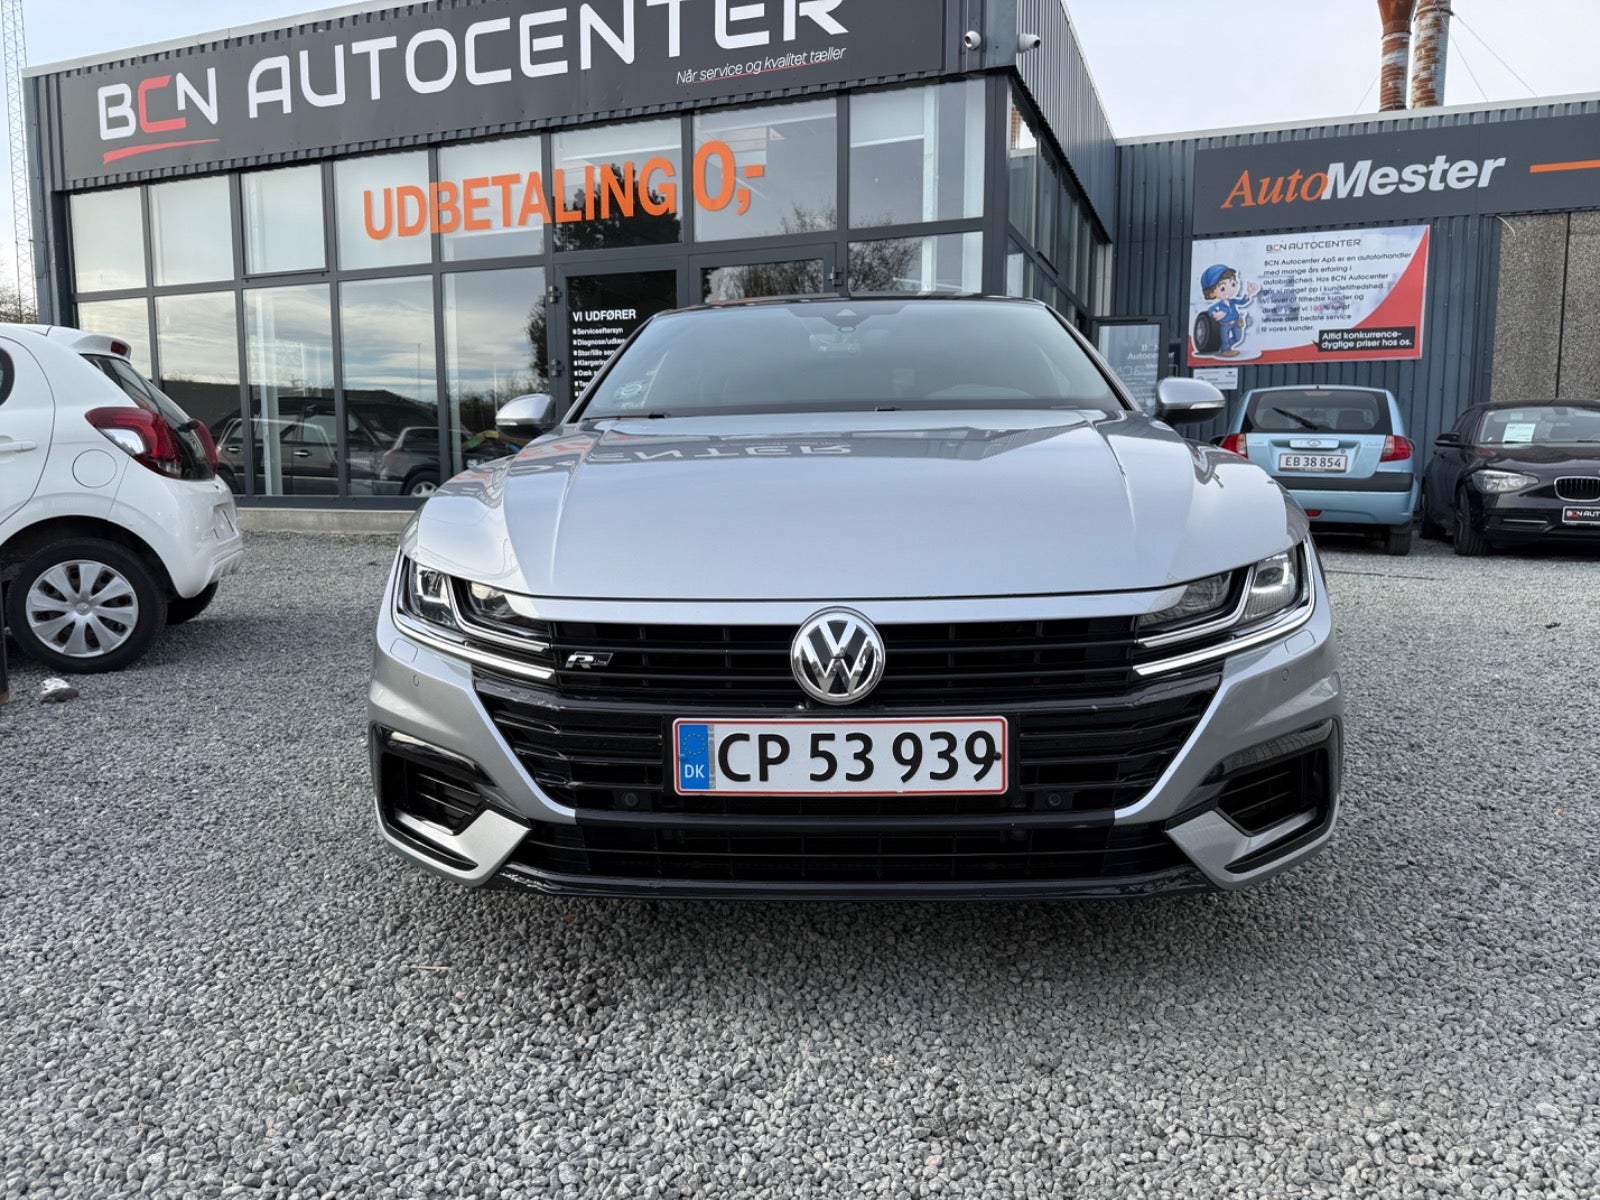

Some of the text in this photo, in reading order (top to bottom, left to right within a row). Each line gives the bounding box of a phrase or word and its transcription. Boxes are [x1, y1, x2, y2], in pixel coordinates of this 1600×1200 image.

[97, 0, 848, 141] BCN AUTOCENTER
[676, 46, 847, 85] Når service og kvalitet tæller
[1220, 155, 1507, 209] AutoMester
[363, 157, 677, 241] UDBETALING
[1265, 239, 1361, 252] BCN AUTOCENTER
[1281, 258, 1320, 266] Autocenter
[1357, 252, 1412, 261] autoforhandler
[1281, 268, 1307, 277] mange
[1308, 266, 1319, 274] års
[1320, 265, 1348, 274] erfaring
[1331, 274, 1347, 282] BCN
[1348, 273, 1389, 281] Autocenter
[1327, 293, 1352, 301] kunder
[572, 308, 637, 322] VI UDFØRER
[1300, 313, 1324, 321] bedste
[1326, 312, 1352, 320] service
[1288, 324, 1315, 332] kunder.
[1322, 330, 1402, 340] Altid konkurrence-
[1321, 340, 1355, 350] dygtige
[1356, 339, 1380, 349] priser
[1381, 338, 1397, 347] hos
[1285, 456, 1341, 468] EB 38 854
[683, 730, 997, 784] DK CP 53 939
